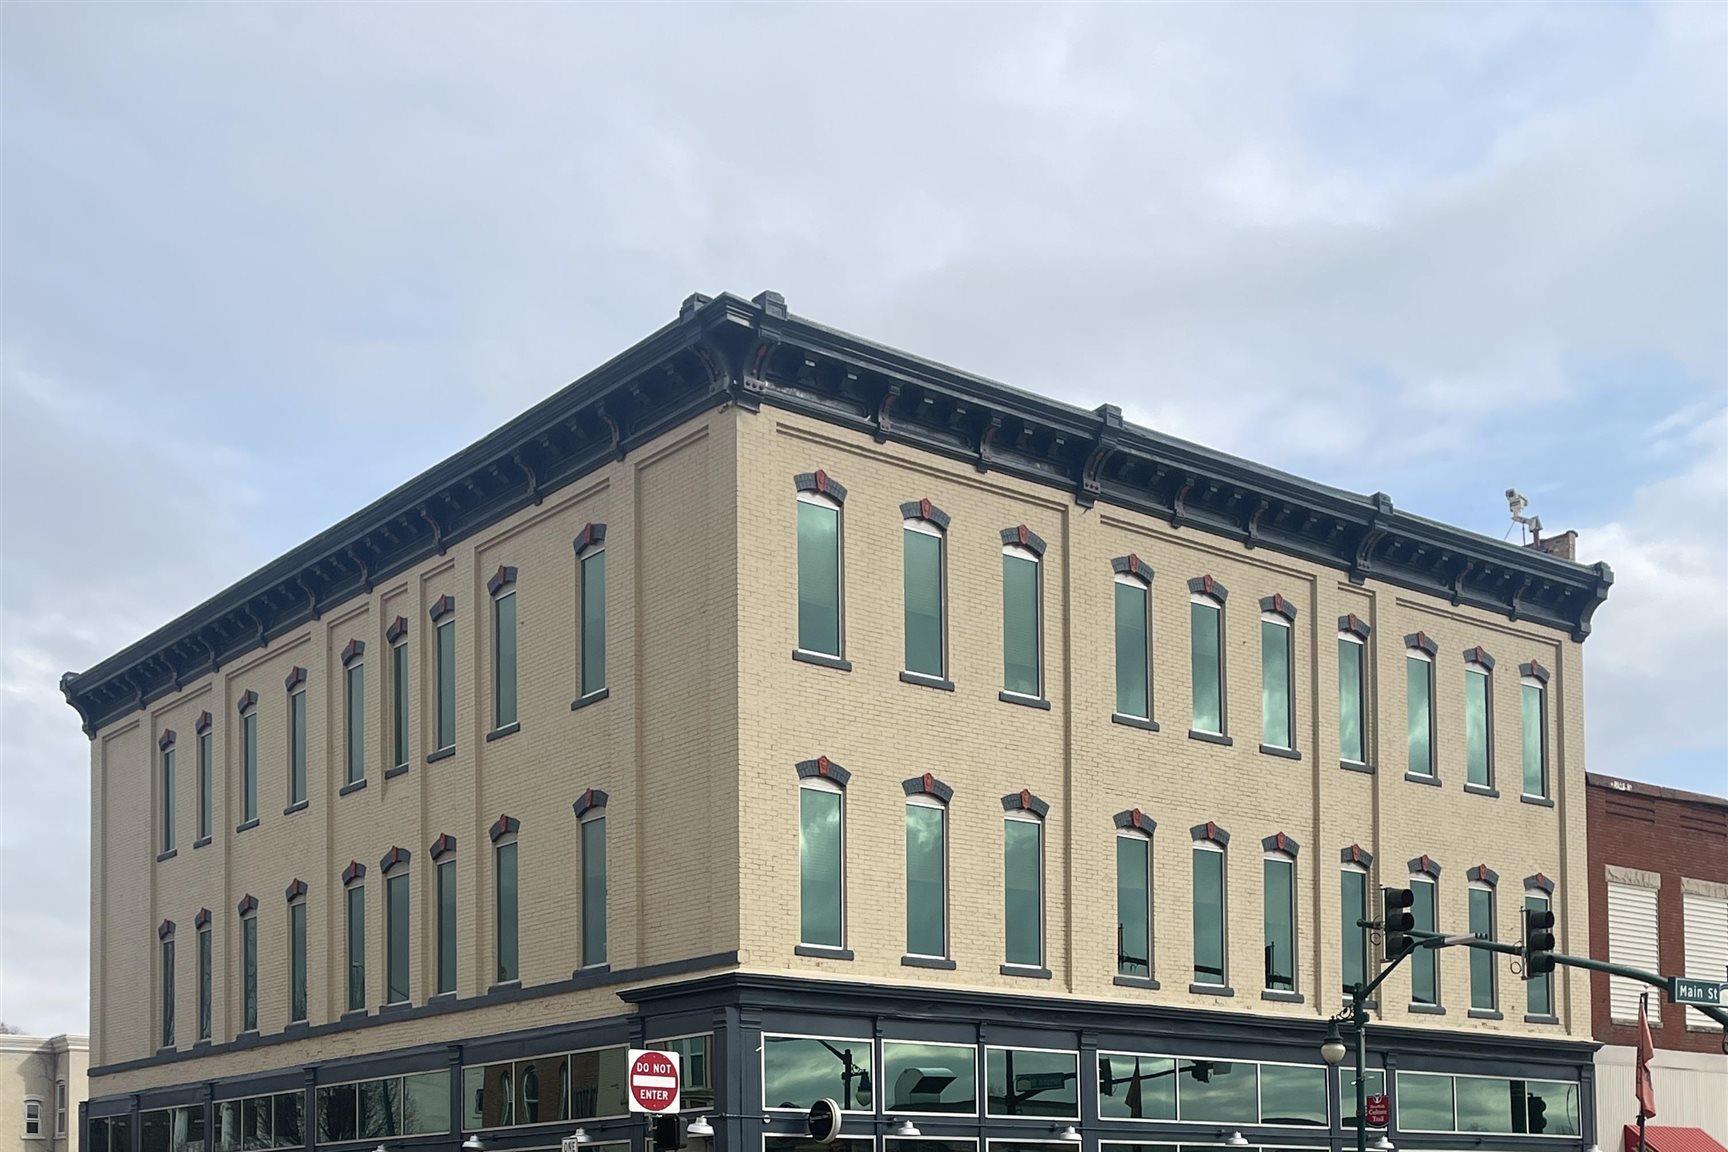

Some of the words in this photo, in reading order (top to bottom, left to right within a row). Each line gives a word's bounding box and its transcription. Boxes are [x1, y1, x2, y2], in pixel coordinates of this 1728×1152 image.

[1680, 985, 1703, 998] Main
[1708, 988, 1718, 1000] St
[637, 1062, 650, 1072] DO
[653, 1063, 671, 1074] NOT
[640, 1089, 669, 1100] ENTER
[564, 1142, 575, 1152] ONE
